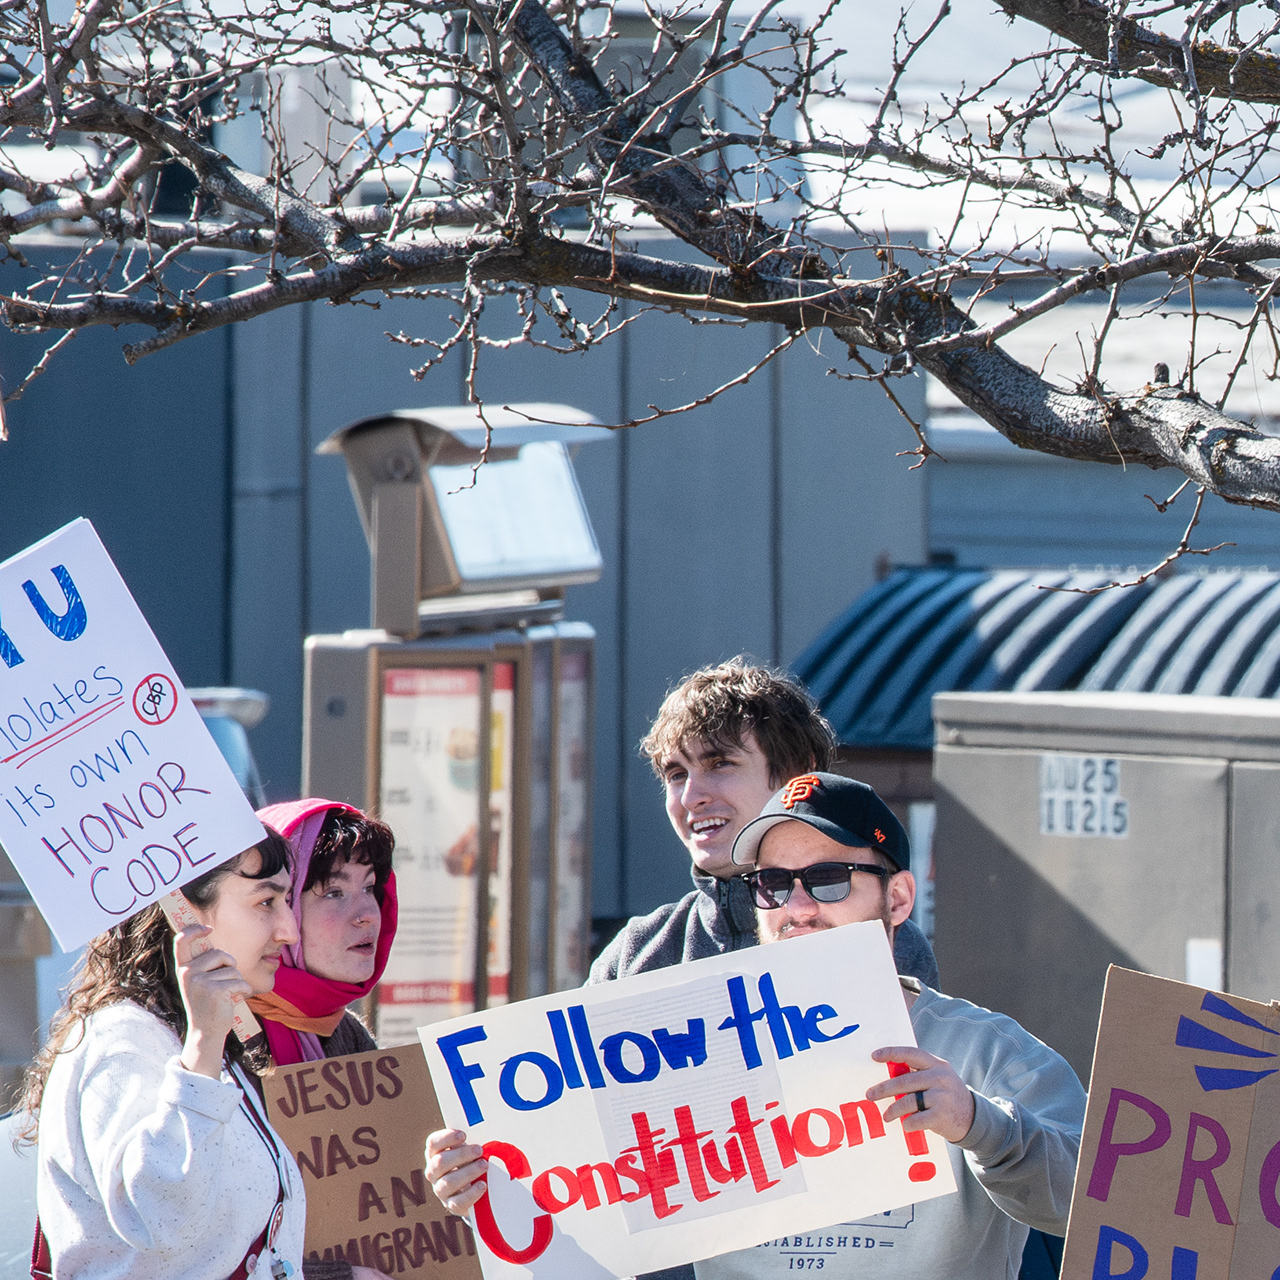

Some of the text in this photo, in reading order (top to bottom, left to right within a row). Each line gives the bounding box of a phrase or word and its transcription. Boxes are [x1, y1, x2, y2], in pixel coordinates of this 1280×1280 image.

[70, 729, 150, 788] own
[42, 762, 212, 878] HONOR
[91, 822, 216, 915] CODE
[276, 1055, 404, 1118] JESUS
[437, 1003, 707, 1127] Follow
[718, 972, 860, 1071] the
[357, 1169, 427, 1222] AN
[470, 1060, 938, 1266] Constitution!
[789, 1257, 825, 1270] 1973
